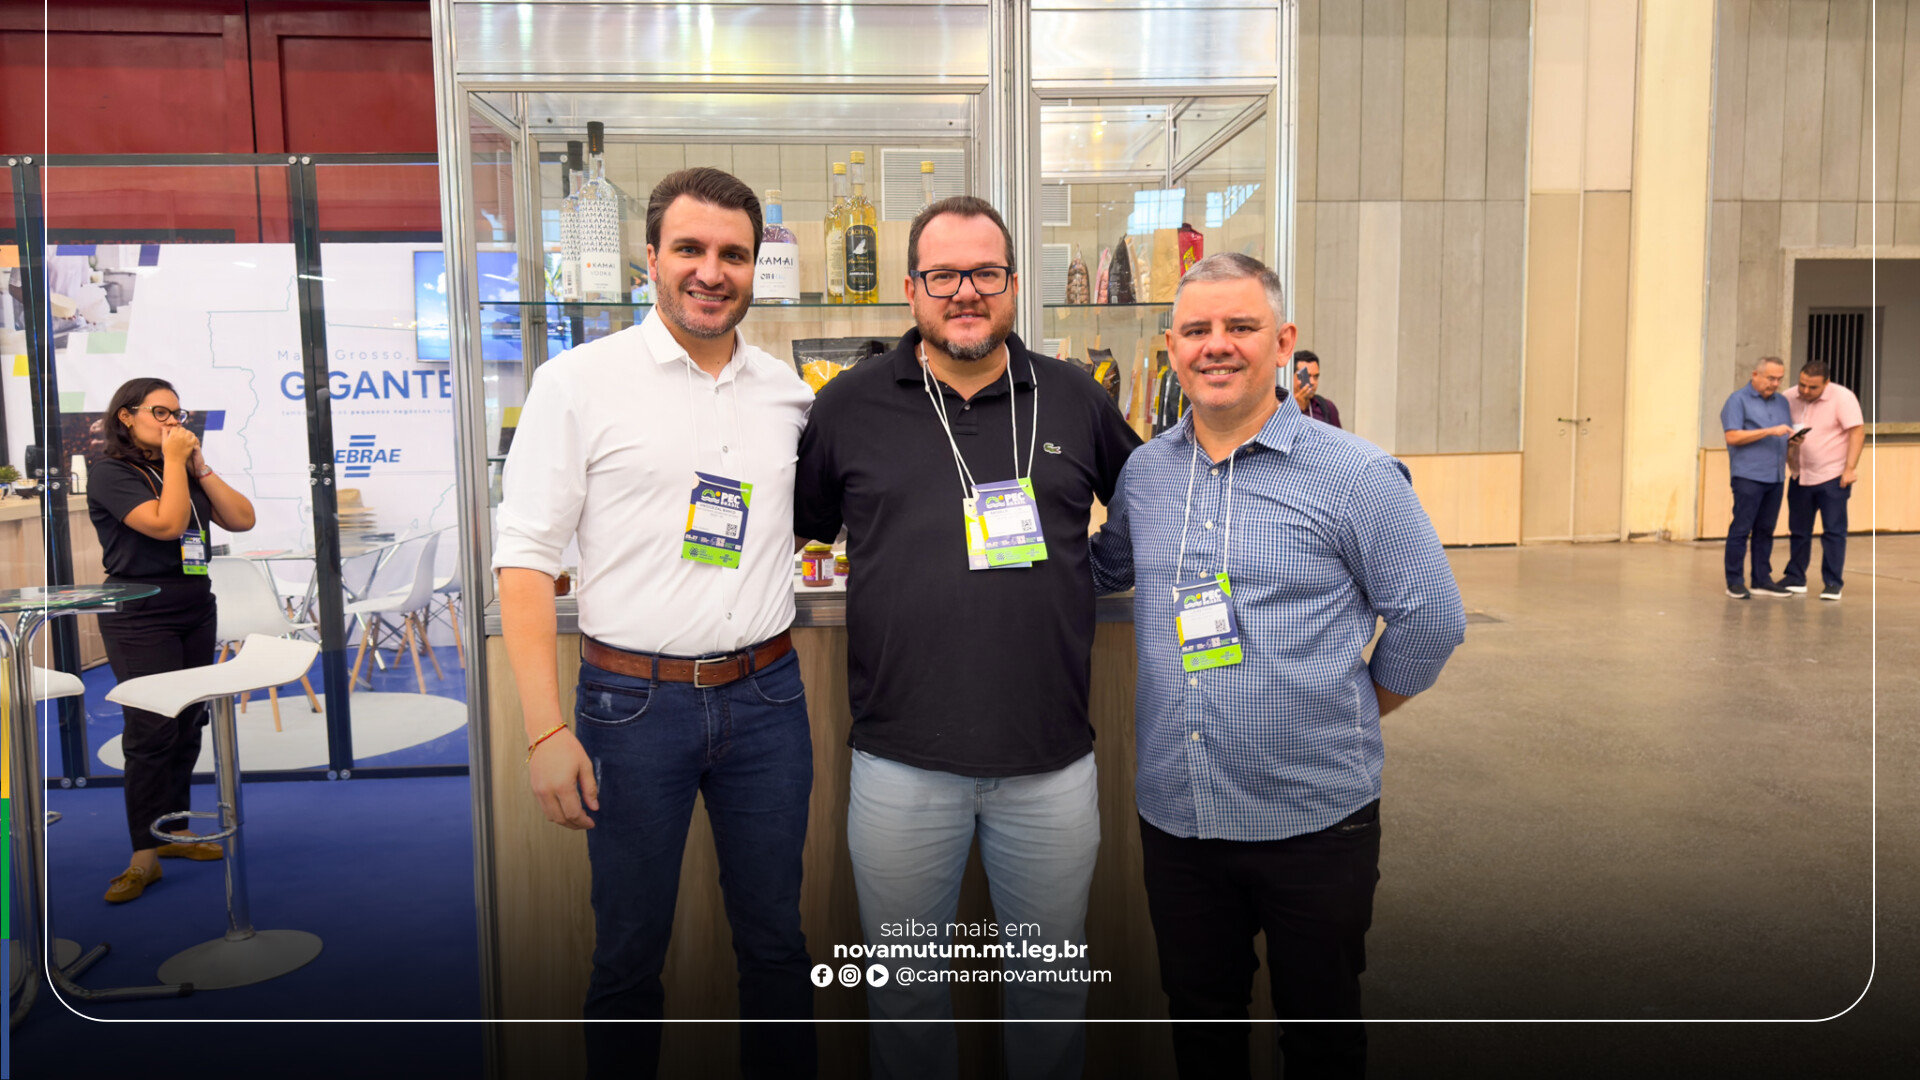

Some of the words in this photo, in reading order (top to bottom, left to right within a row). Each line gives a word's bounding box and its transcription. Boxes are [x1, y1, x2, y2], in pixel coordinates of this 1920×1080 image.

[758, 256, 794, 266] KAMAI
[280, 370, 452, 401] GGANTE
[334, 448, 402, 464] EBRAE
[720, 492, 741, 504] PEC
